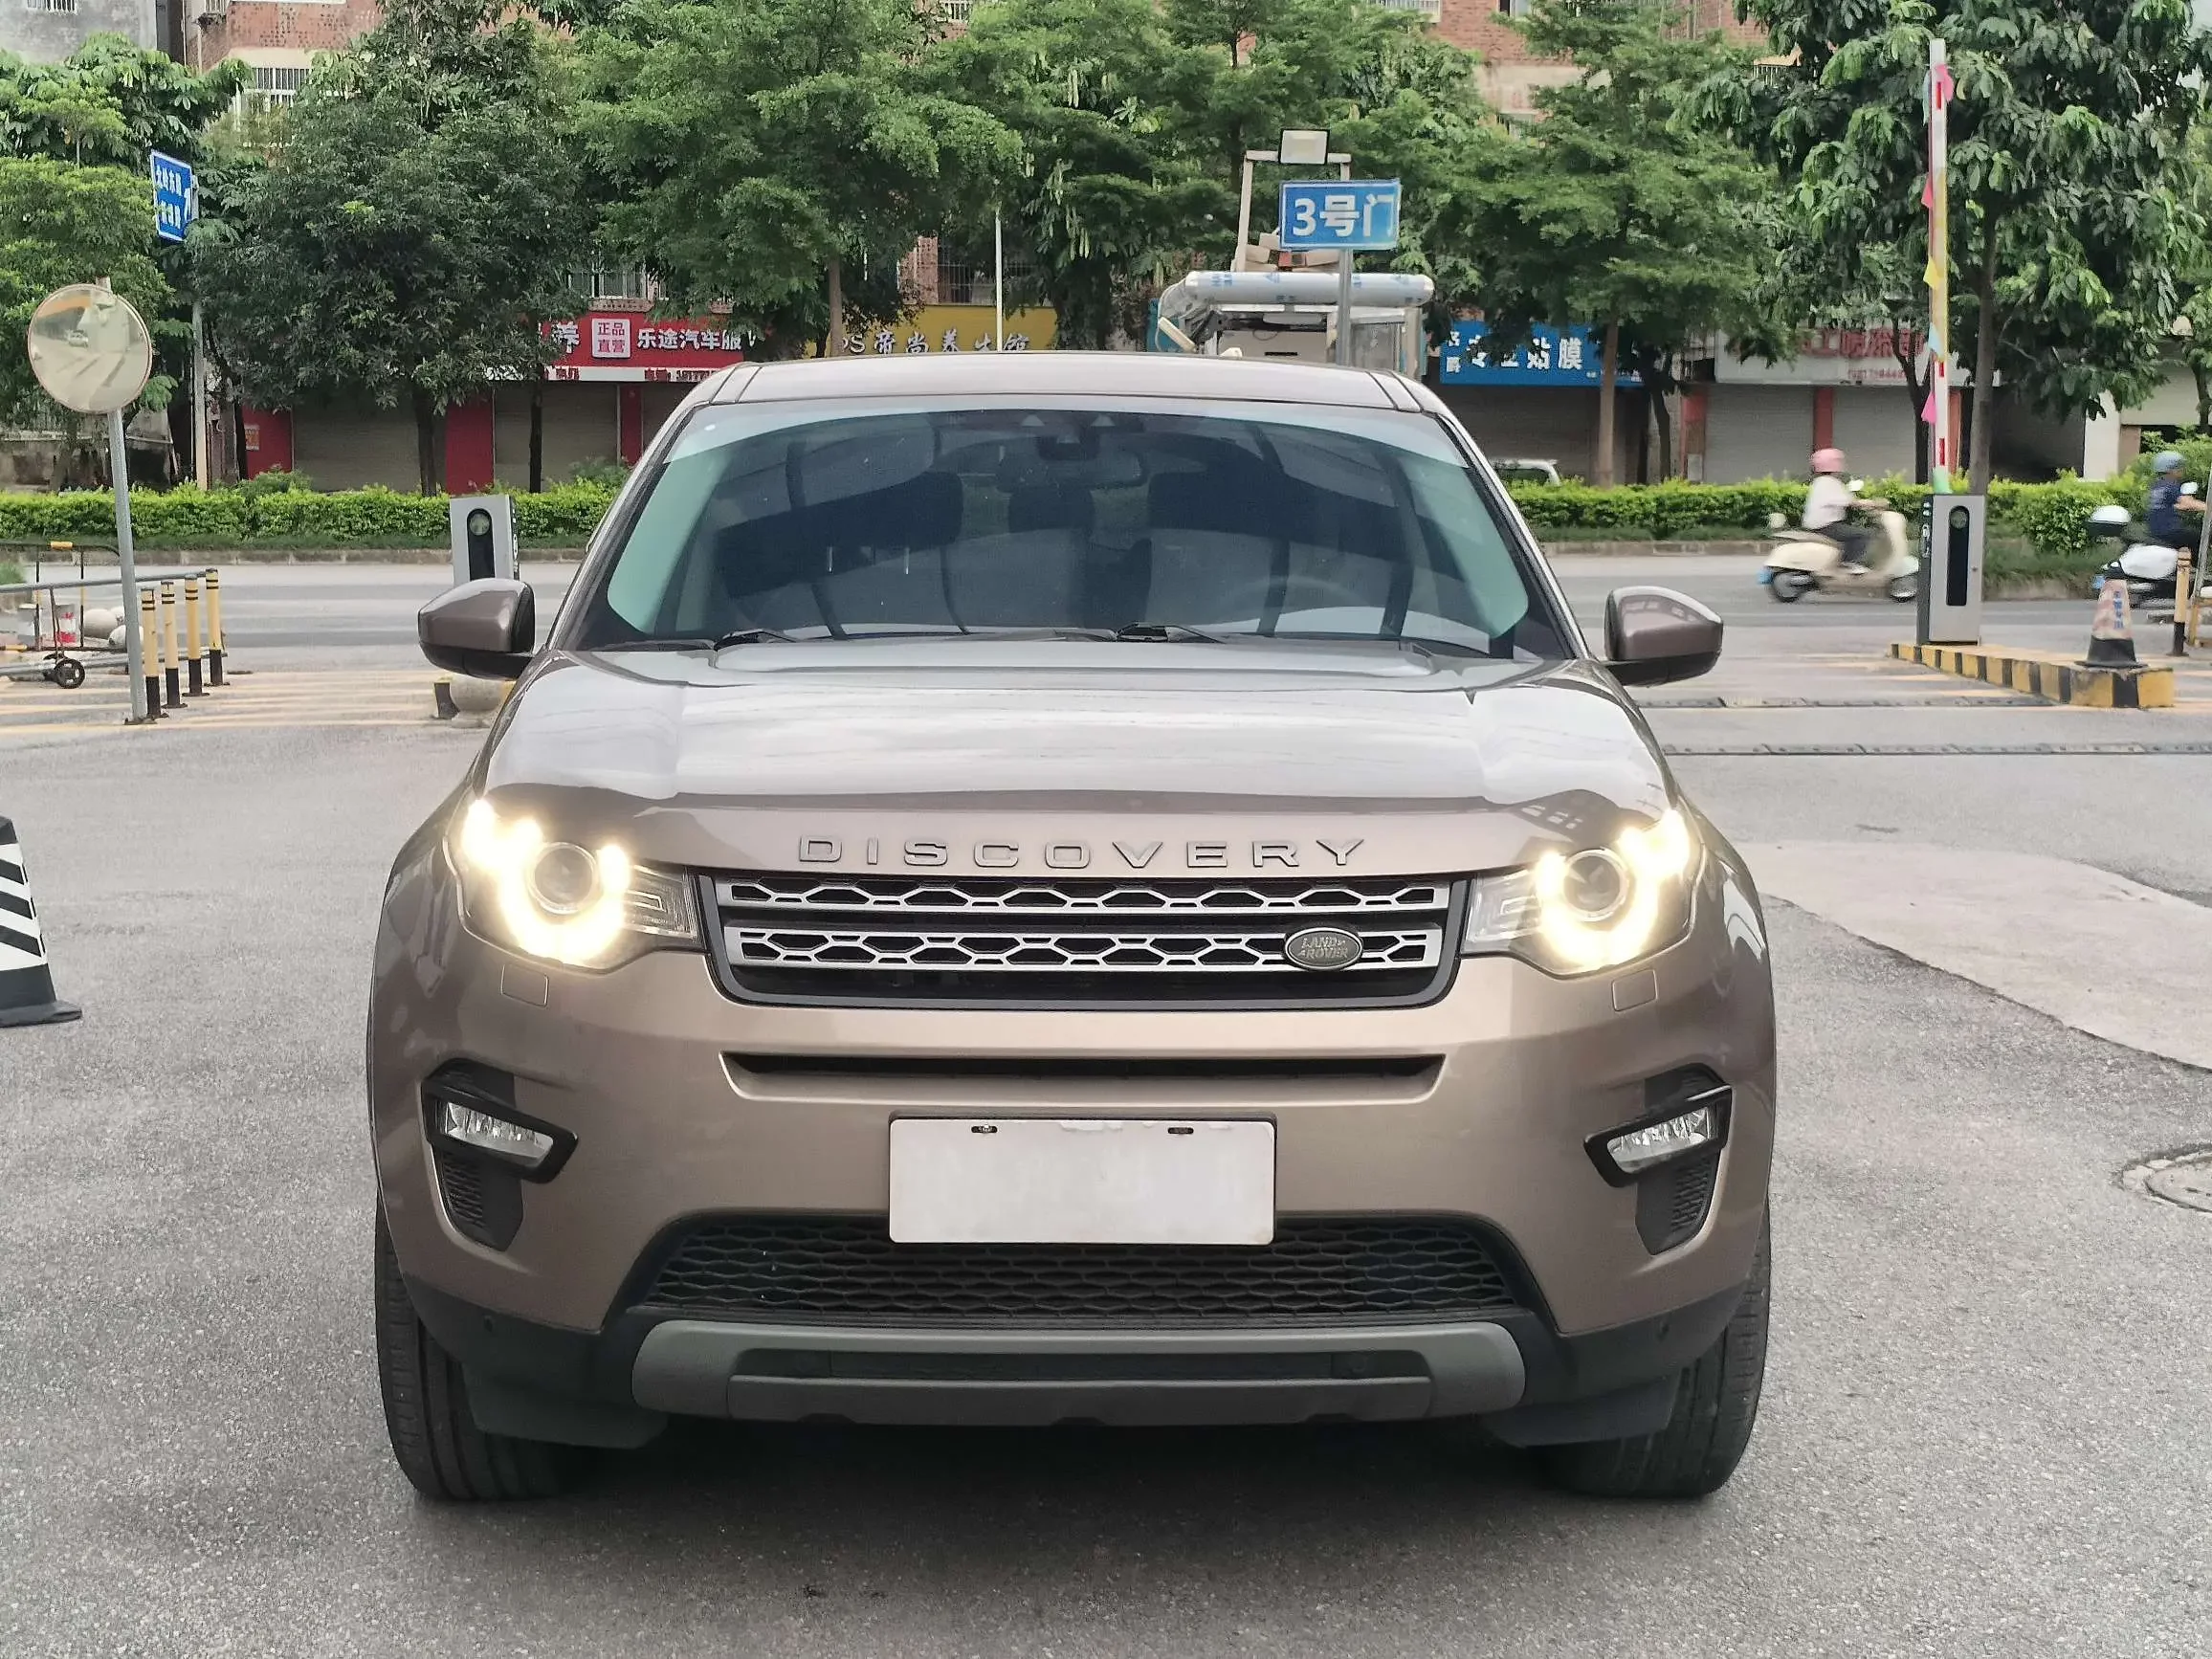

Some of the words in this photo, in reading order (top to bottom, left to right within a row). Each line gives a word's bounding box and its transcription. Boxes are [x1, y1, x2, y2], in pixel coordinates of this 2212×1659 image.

[1293, 194, 1394, 237] 3号门
[598, 322, 625, 335] 正品
[637, 328, 756, 351] 乐途汽车服
[798, 834, 1364, 869] DISCOVERY
[1301, 937, 1338, 949] LAND
[1306, 947, 1348, 960] ROVER
